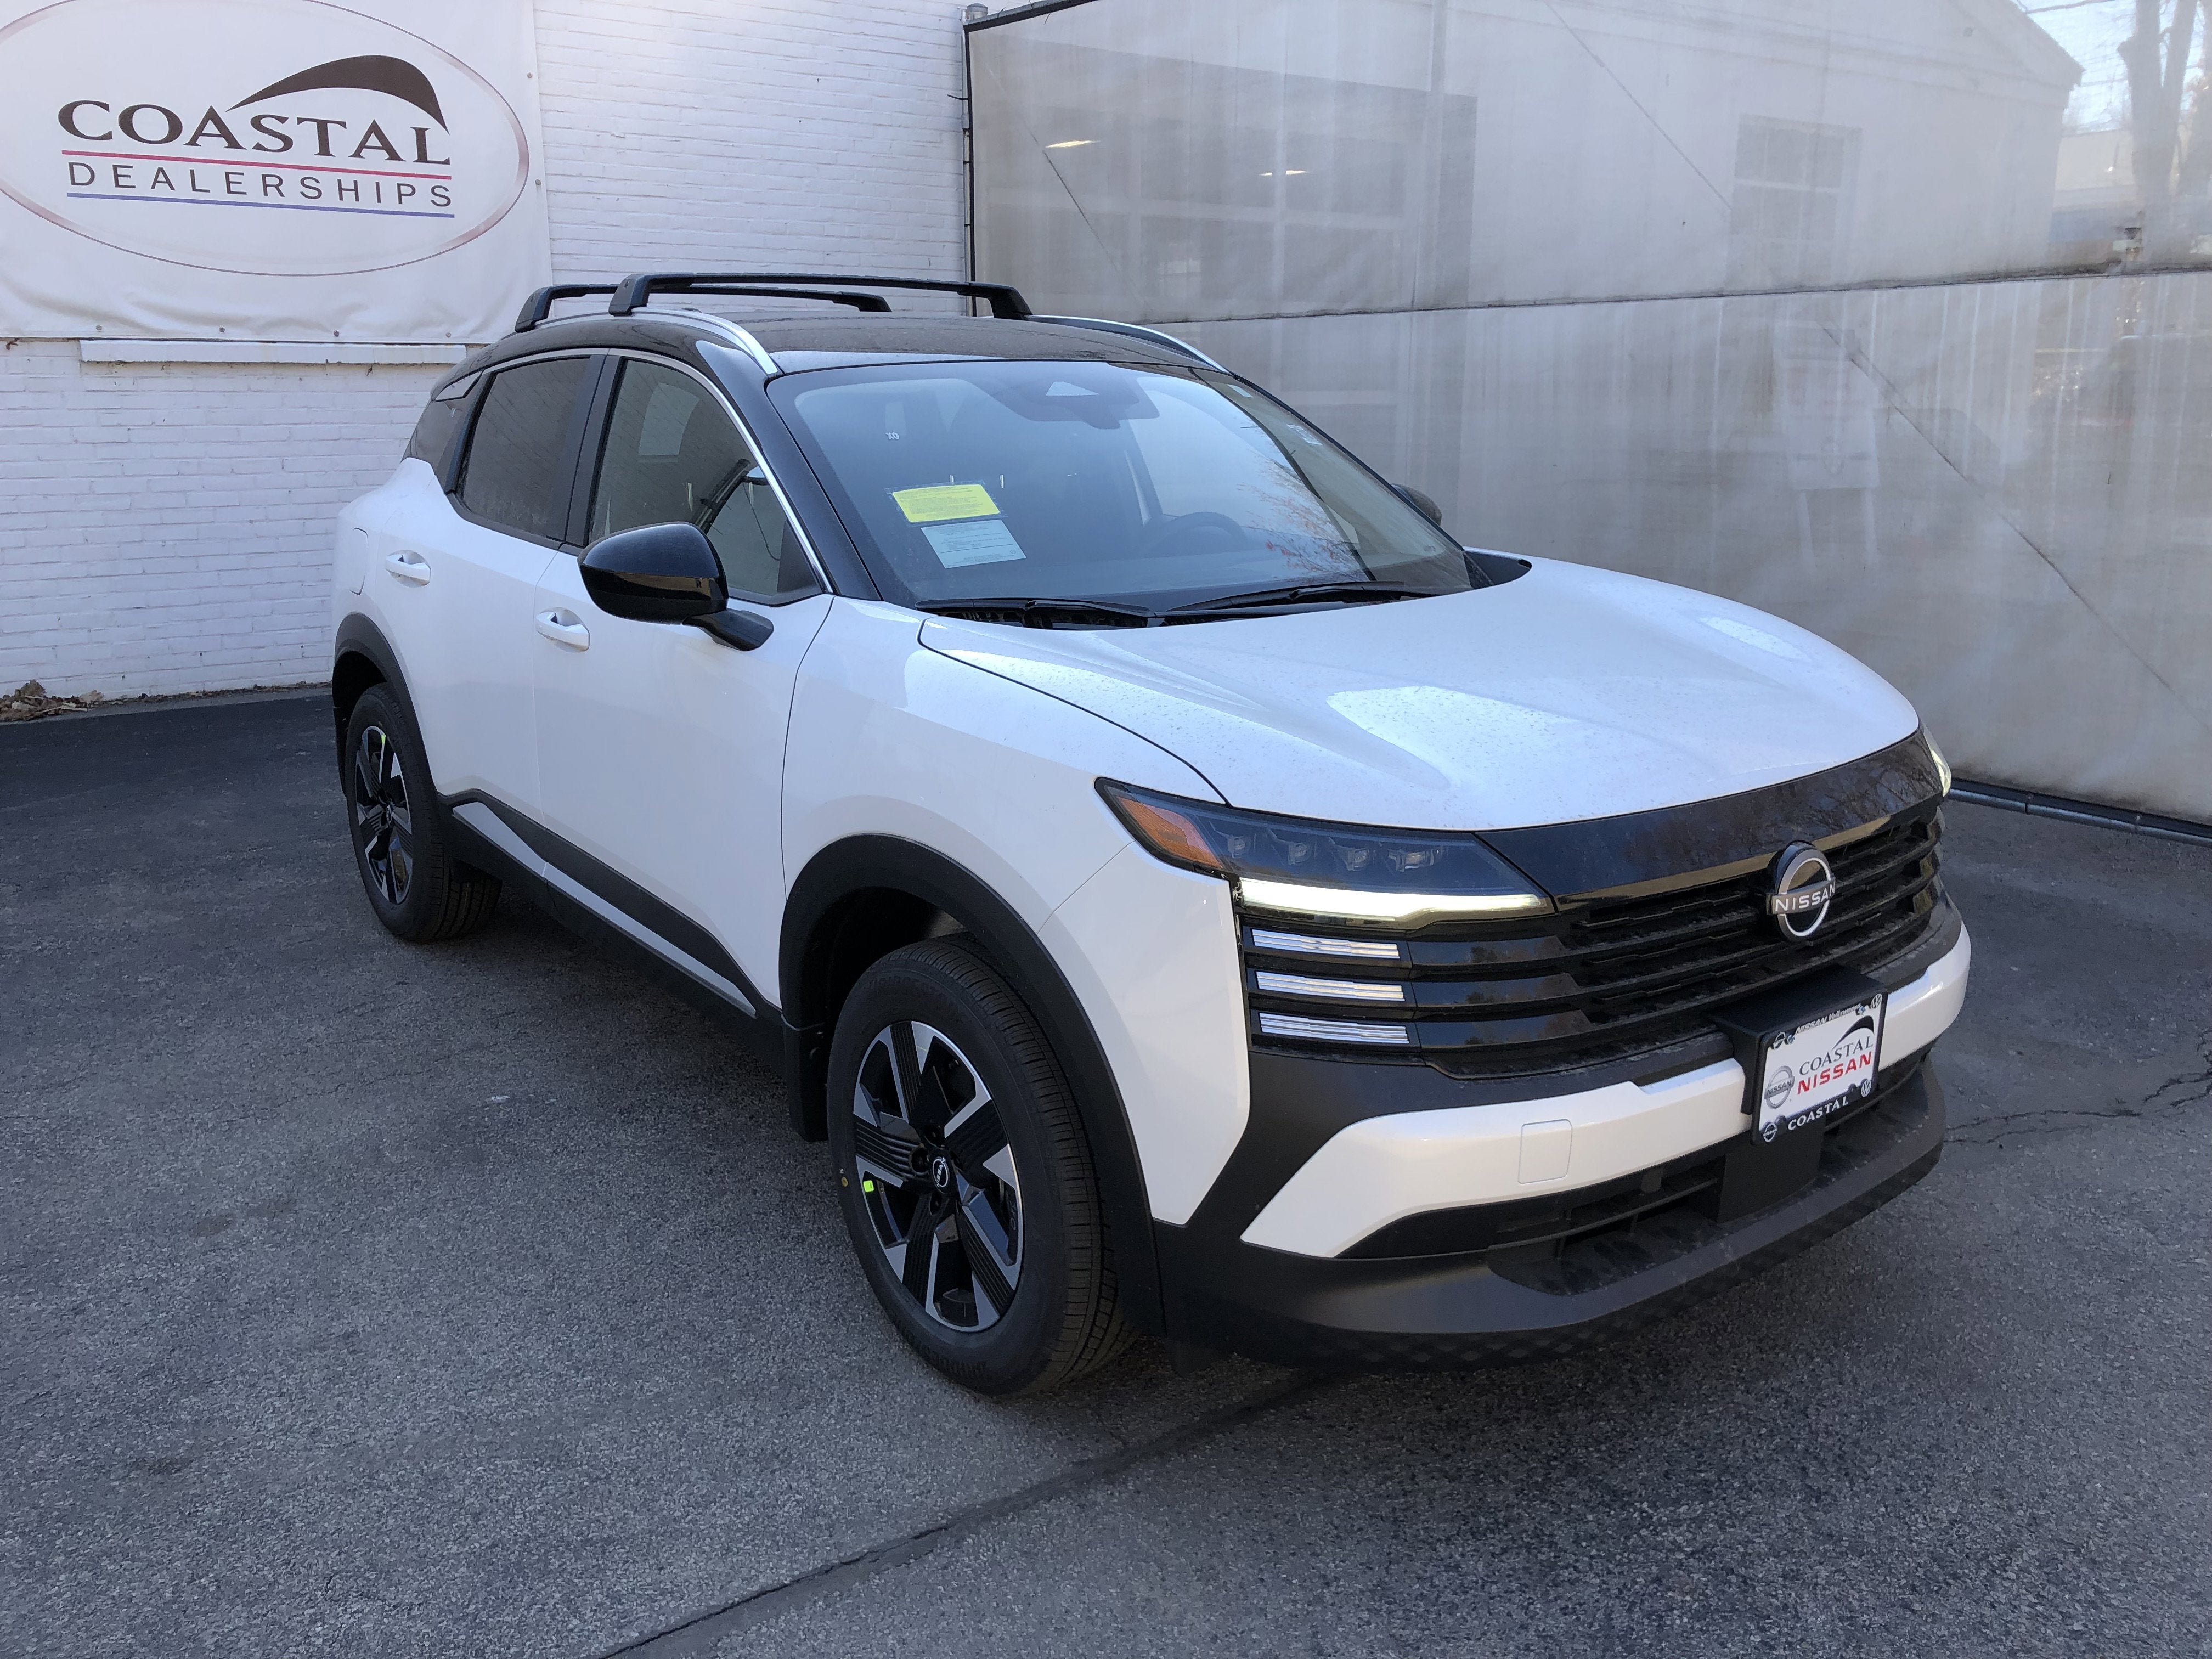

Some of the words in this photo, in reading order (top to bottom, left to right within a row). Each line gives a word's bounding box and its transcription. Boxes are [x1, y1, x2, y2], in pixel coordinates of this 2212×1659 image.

[58, 100, 451, 165] COASTAL
[68, 161, 452, 207] DEALERSHIPS
[1775, 884, 1836, 912] NISSAN
[1797, 1051, 1872, 1095] NISSAN
[1799, 1035, 1874, 1076] COASTAL
[1767, 1080, 1792, 1094] NISSAN
[1787, 1096, 1849, 1131] COASTAL
